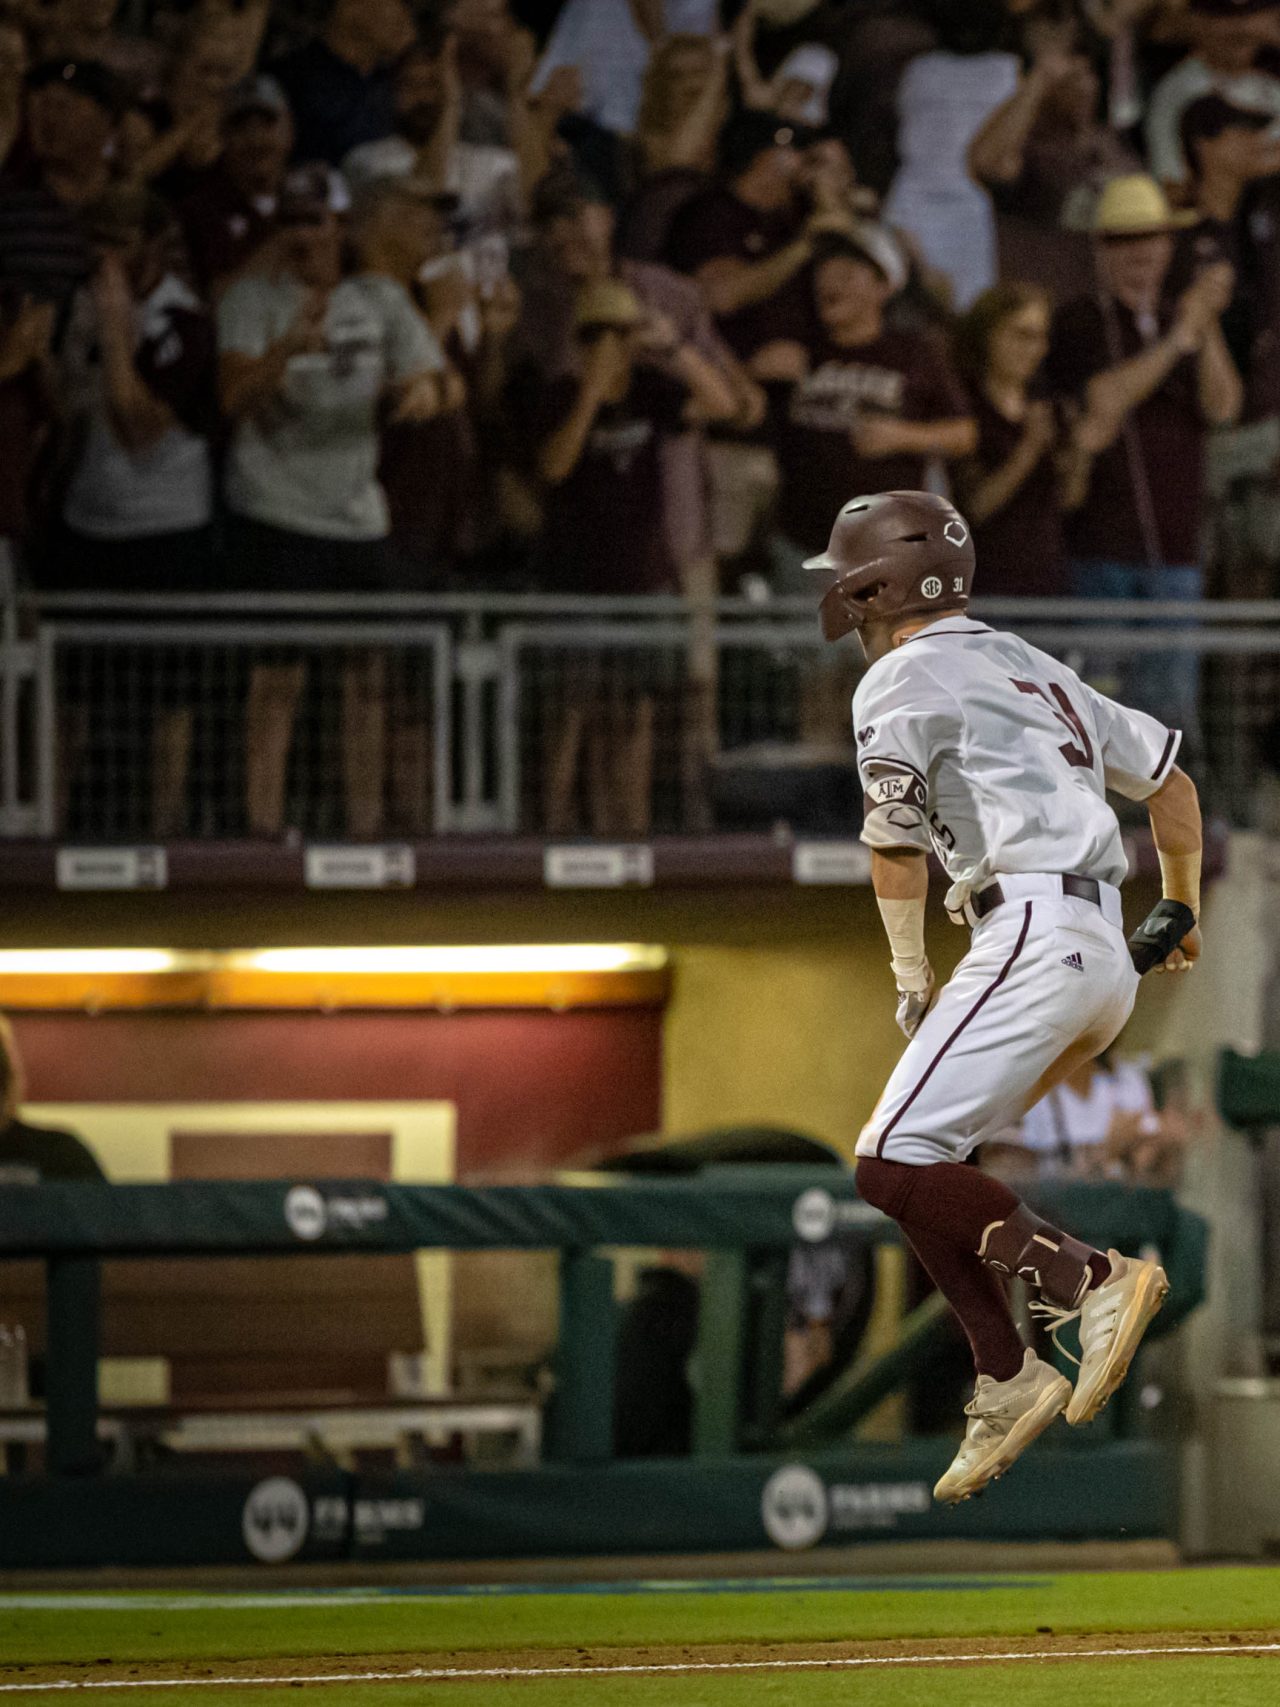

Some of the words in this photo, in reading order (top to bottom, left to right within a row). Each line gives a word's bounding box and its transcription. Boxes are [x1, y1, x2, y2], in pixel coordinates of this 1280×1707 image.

[923, 579, 941, 596] SEC
[953, 577, 963, 592] 31
[1061, 958, 1084, 972] adidas
